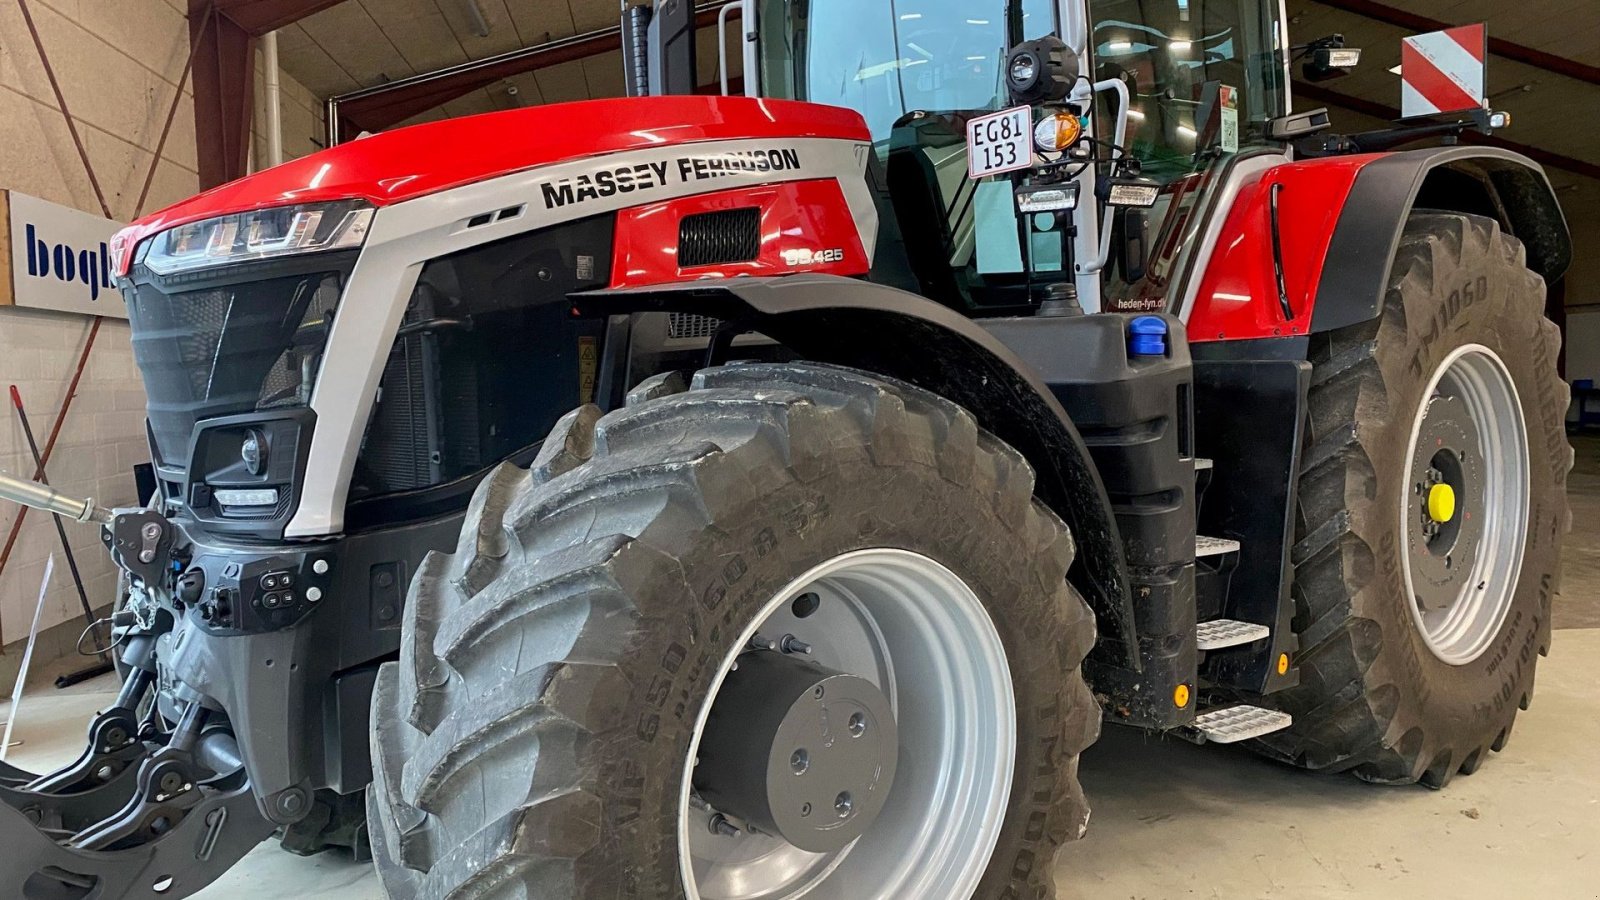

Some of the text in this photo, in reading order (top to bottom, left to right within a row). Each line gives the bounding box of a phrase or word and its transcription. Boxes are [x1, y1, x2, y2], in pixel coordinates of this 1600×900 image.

[974, 113, 1022, 147] EG81
[983, 141, 1017, 170] 153
[540, 148, 800, 209] MASSEY FERGUSON
[1118, 298, 1167, 310] heden-fyn.dk
[1409, 275, 1488, 377] TM1060
